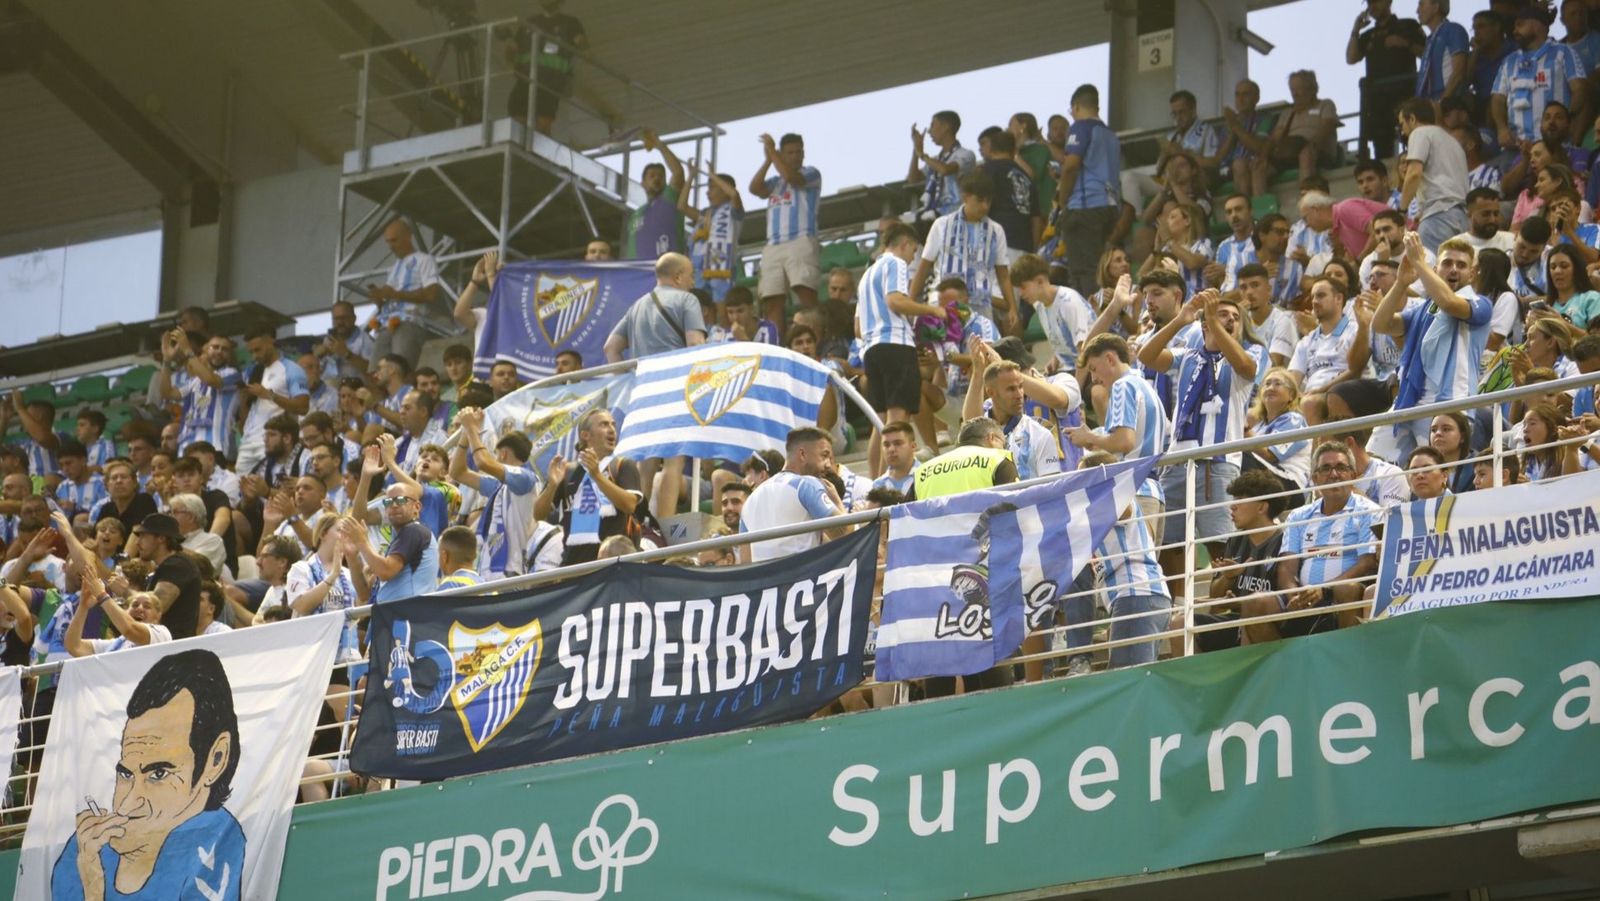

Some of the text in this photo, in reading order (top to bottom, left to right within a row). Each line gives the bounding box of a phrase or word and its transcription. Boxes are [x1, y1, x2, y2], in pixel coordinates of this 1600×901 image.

[1150, 48, 1160, 65] 3
[1396, 506, 1600, 563] PEÑA MALAGUISTA
[1237, 574, 1272, 592] UNESCO
[1391, 549, 1594, 597] SAN PEDRO ALCÁNTARA
[1386, 593, 1485, 616] MALAGUISMO
[1489, 589, 1518, 601] POR
[552, 558, 857, 710] SUPERBASTI
[460, 636, 526, 698] MALAGA C.F.
[548, 664, 845, 738] PEÑA MALAGUISTA
[415, 729, 439, 748] BASTI
[828, 660, 1600, 847] Supermerca
